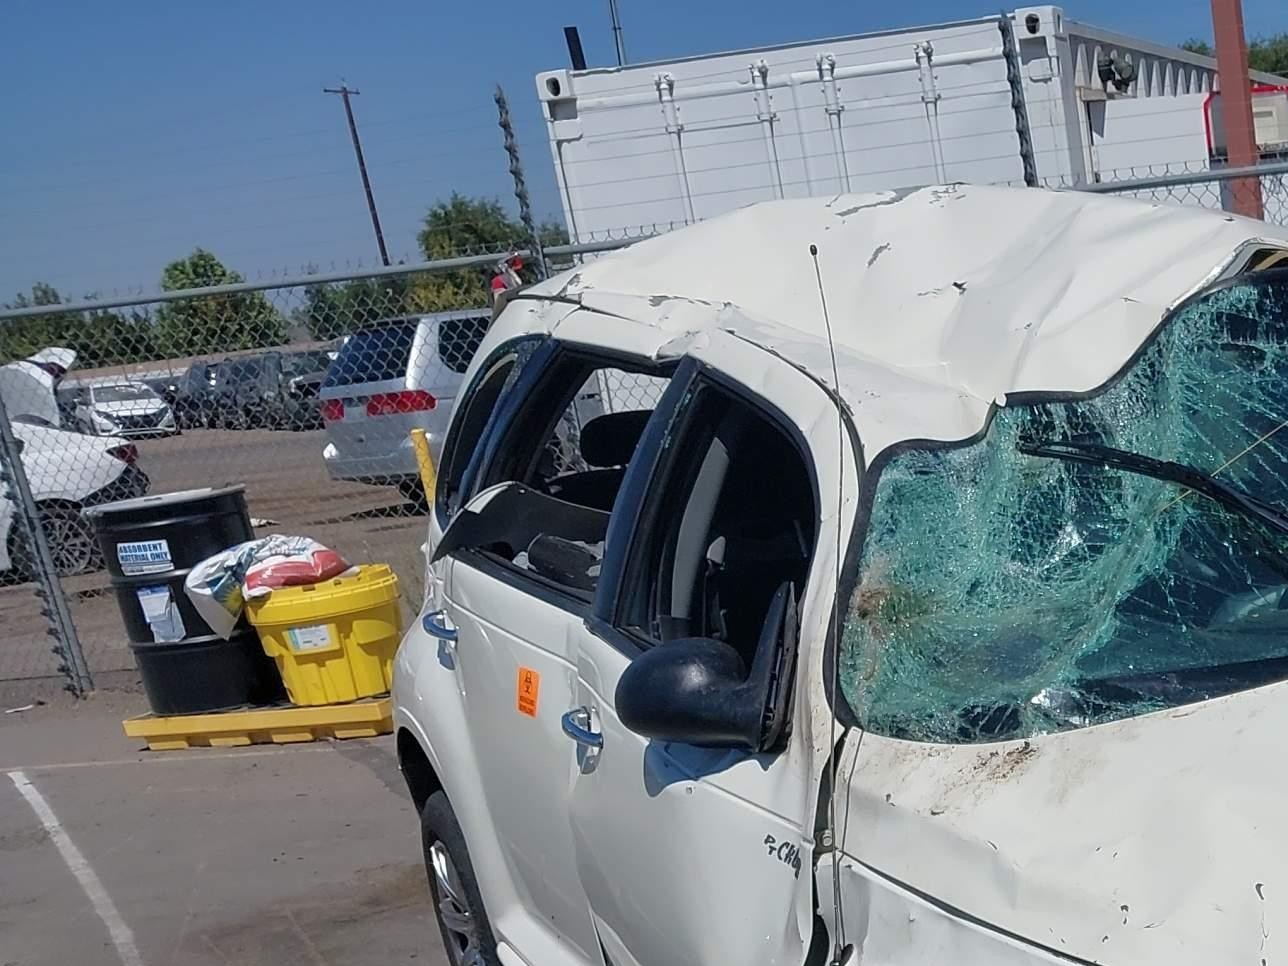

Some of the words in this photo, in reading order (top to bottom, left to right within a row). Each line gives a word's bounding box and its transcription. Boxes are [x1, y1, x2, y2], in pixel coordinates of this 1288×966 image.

[119, 543, 163, 554] ABSORBENT
[120, 553, 149, 562] MATERIAL
[150, 551, 168, 560] ONLY
